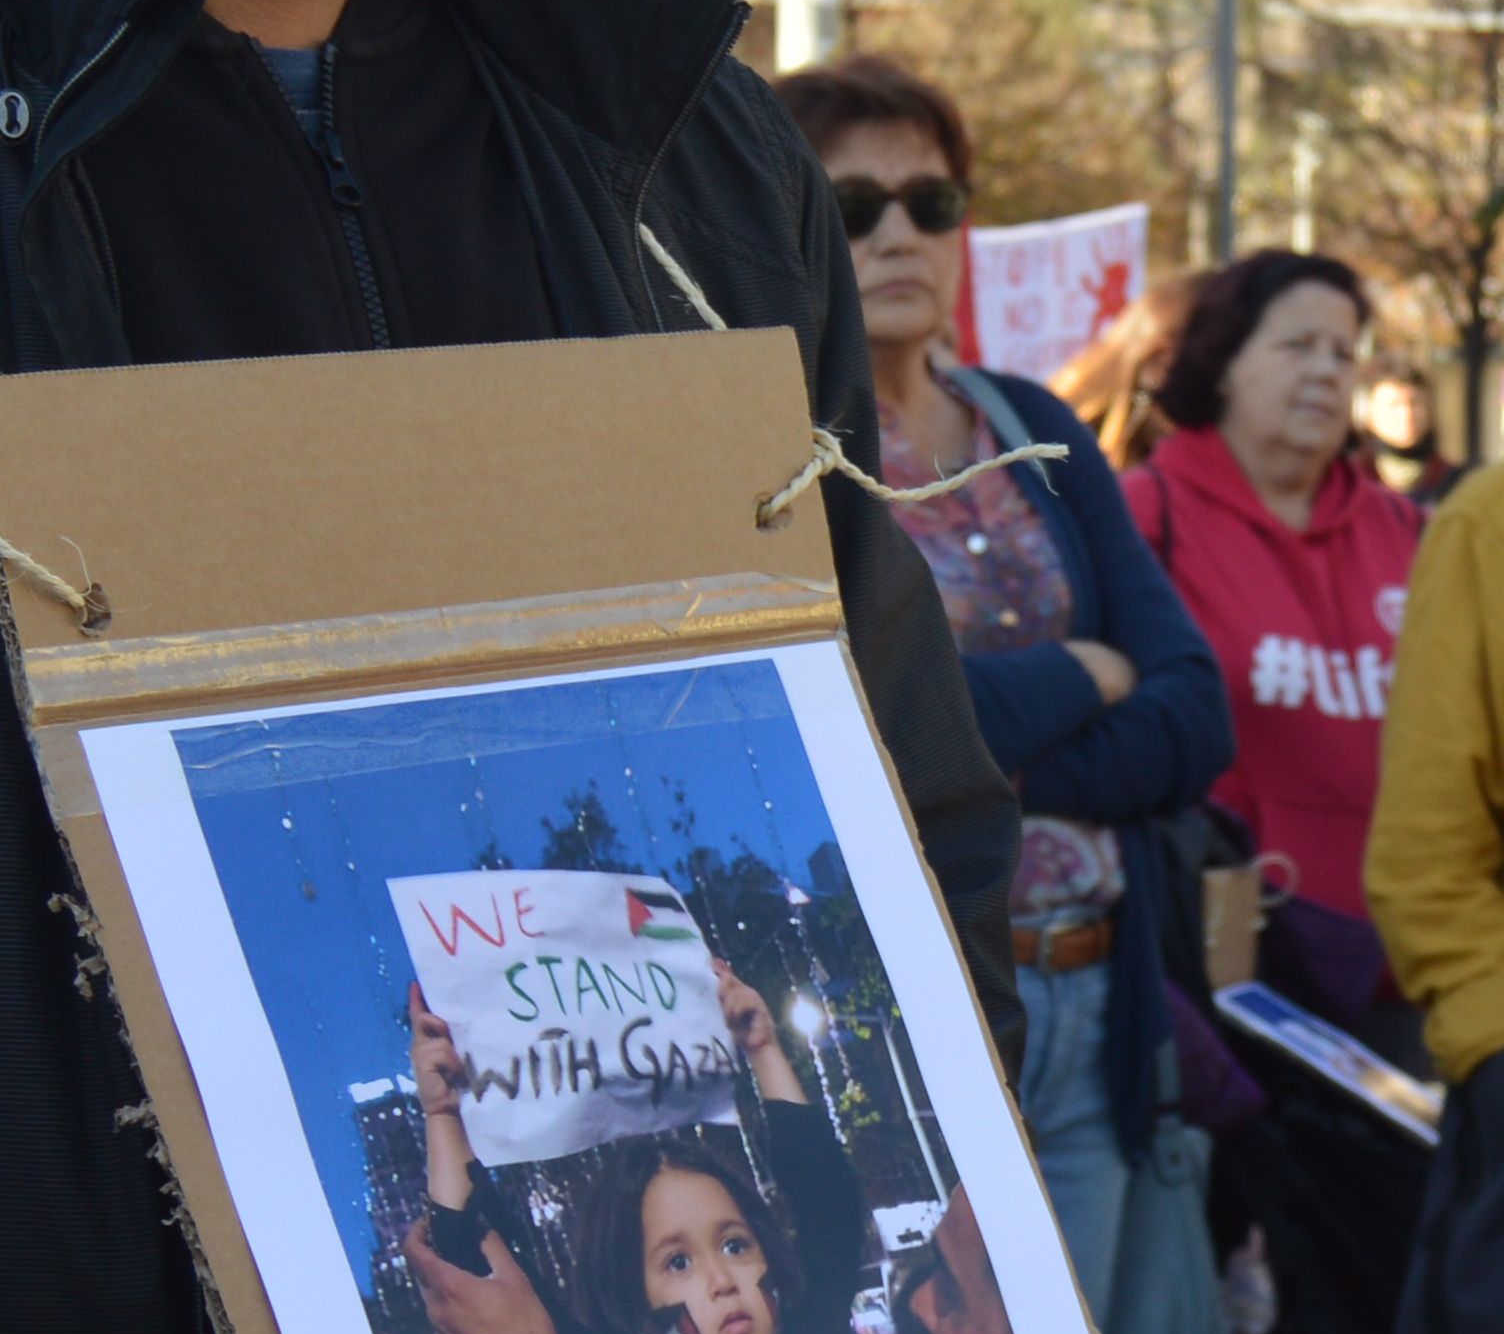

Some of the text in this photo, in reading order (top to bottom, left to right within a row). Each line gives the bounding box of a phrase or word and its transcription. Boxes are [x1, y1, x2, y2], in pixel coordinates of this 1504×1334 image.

[1251, 634, 1397, 720] #lif
[418, 886, 546, 957] WE
[503, 955, 677, 1022] STAND
[462, 1015, 739, 1109] WITH GAZA
